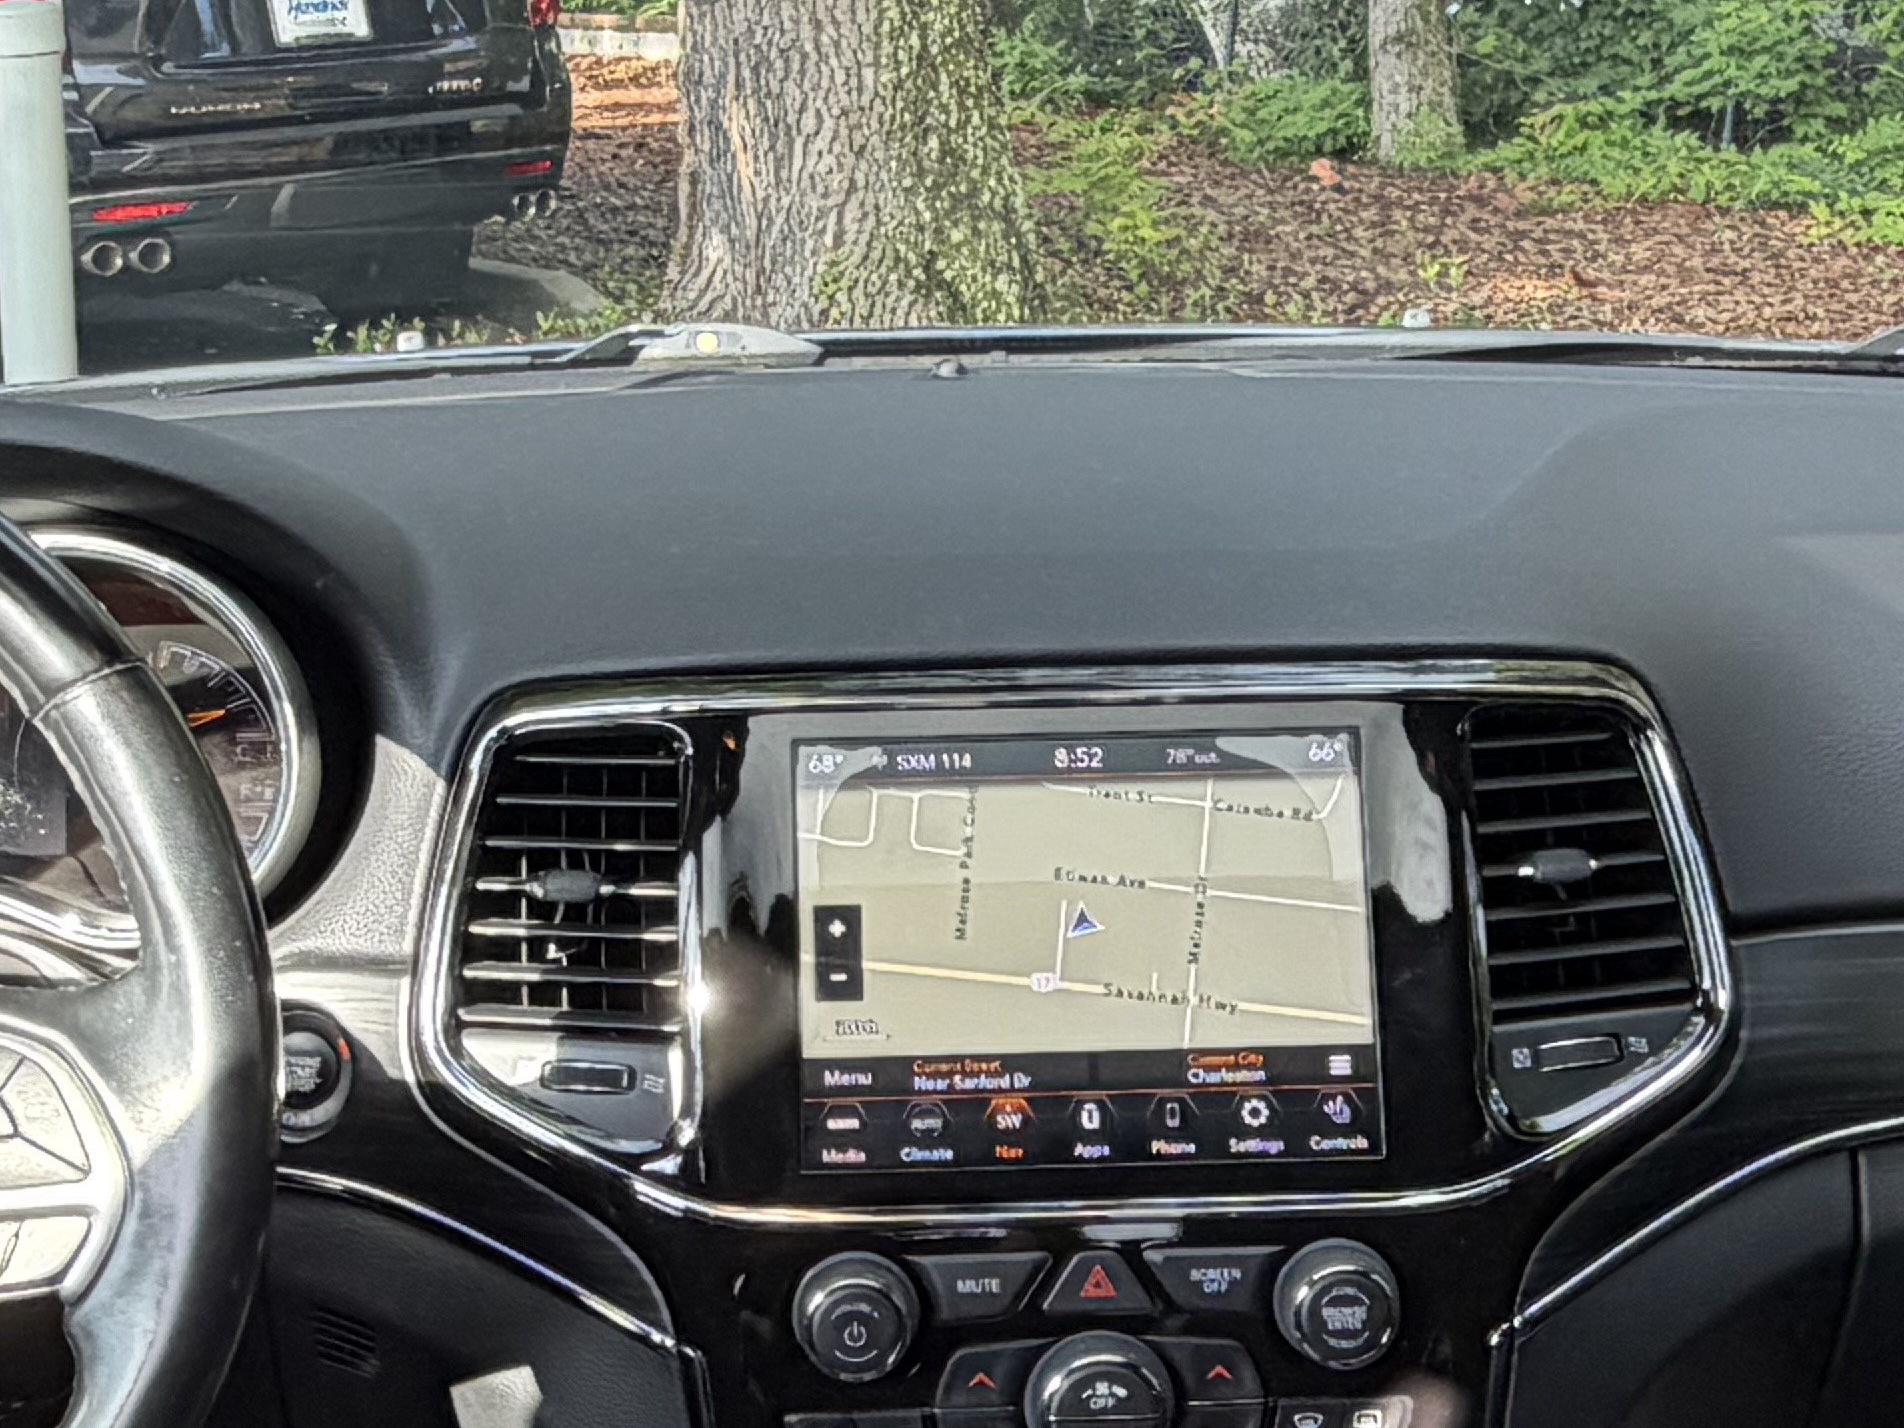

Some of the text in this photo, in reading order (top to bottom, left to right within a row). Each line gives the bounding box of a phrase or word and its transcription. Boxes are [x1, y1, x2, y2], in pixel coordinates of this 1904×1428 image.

[808, 754, 844, 773] 68°
[896, 752, 972, 771] SXM 114
[1054, 747, 1104, 768] 8:52
[823, 1069, 873, 1087] Menu
[1073, 1143, 1111, 1158] Apps
[1151, 1140, 1197, 1156] Phone
[1228, 1137, 1286, 1155] Settings
[1308, 1134, 1370, 1151] Controls
[822, 1148, 867, 1164] Media
[899, 1146, 954, 1162] Climate
[956, 1278, 1002, 1294] MUTE
[1202, 1281, 1229, 1294] OFF
[1090, 1397, 1116, 1410] OFF
